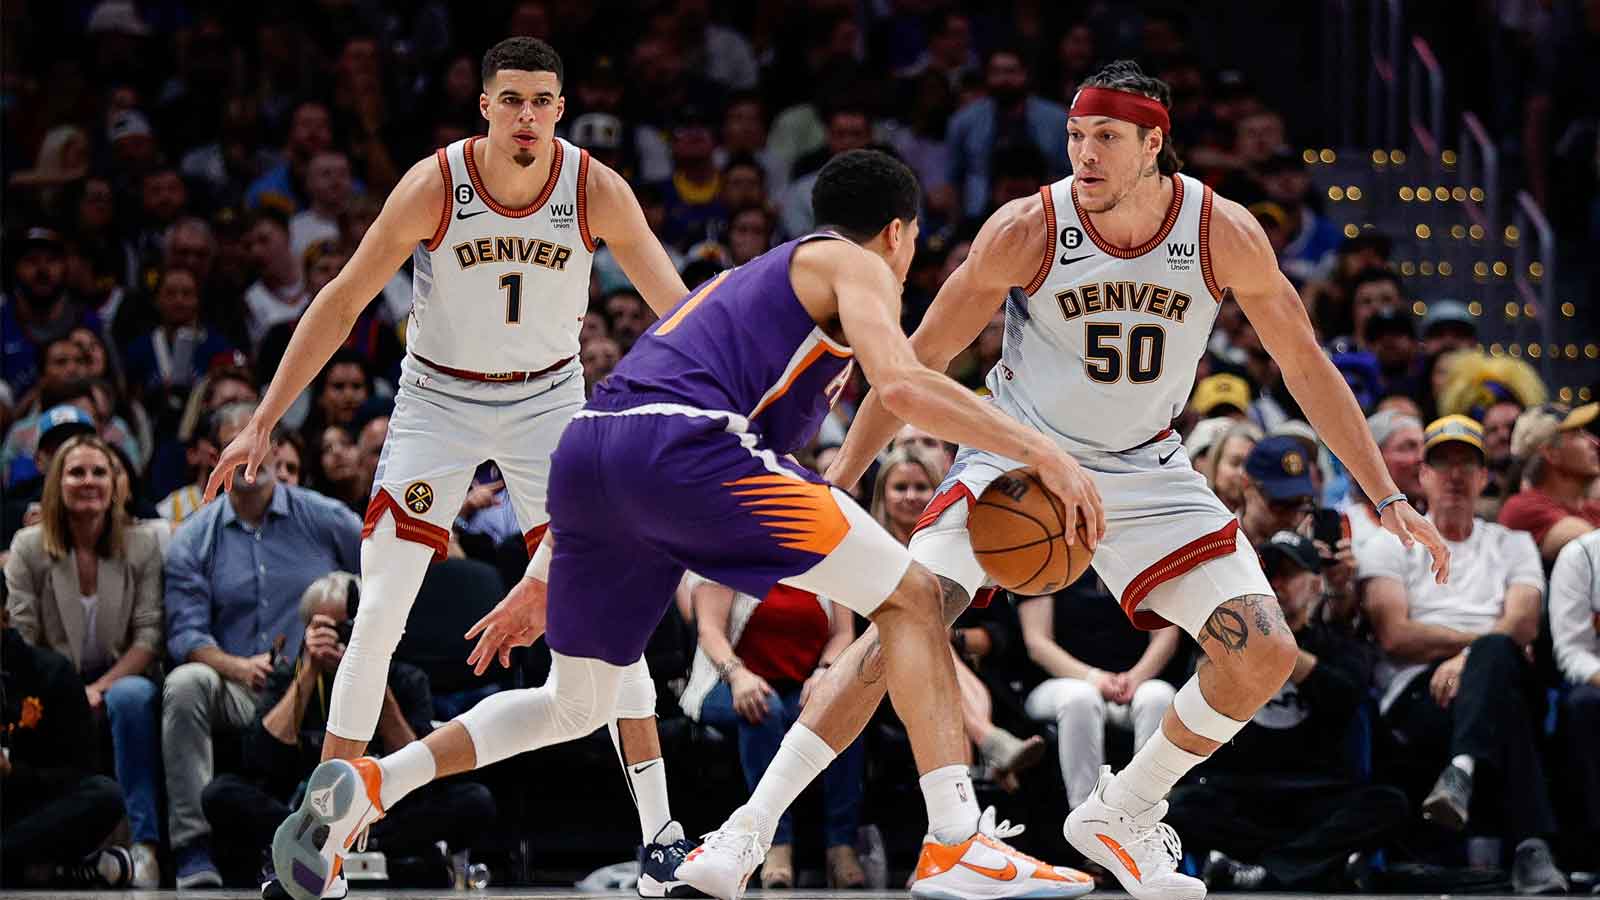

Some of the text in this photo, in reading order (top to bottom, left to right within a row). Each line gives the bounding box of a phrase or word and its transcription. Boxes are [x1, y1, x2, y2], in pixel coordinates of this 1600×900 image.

[458, 186, 471, 202] 6
[550, 204, 574, 217] WU
[1065, 229, 1079, 247] 6
[452, 236, 573, 271] DENVER
[1167, 243, 1195, 257] WU
[1166, 257, 1195, 265] Western
[499, 272, 523, 325] 1
[1055, 281, 1193, 323] DENVER
[1084, 322, 1167, 385] 50
